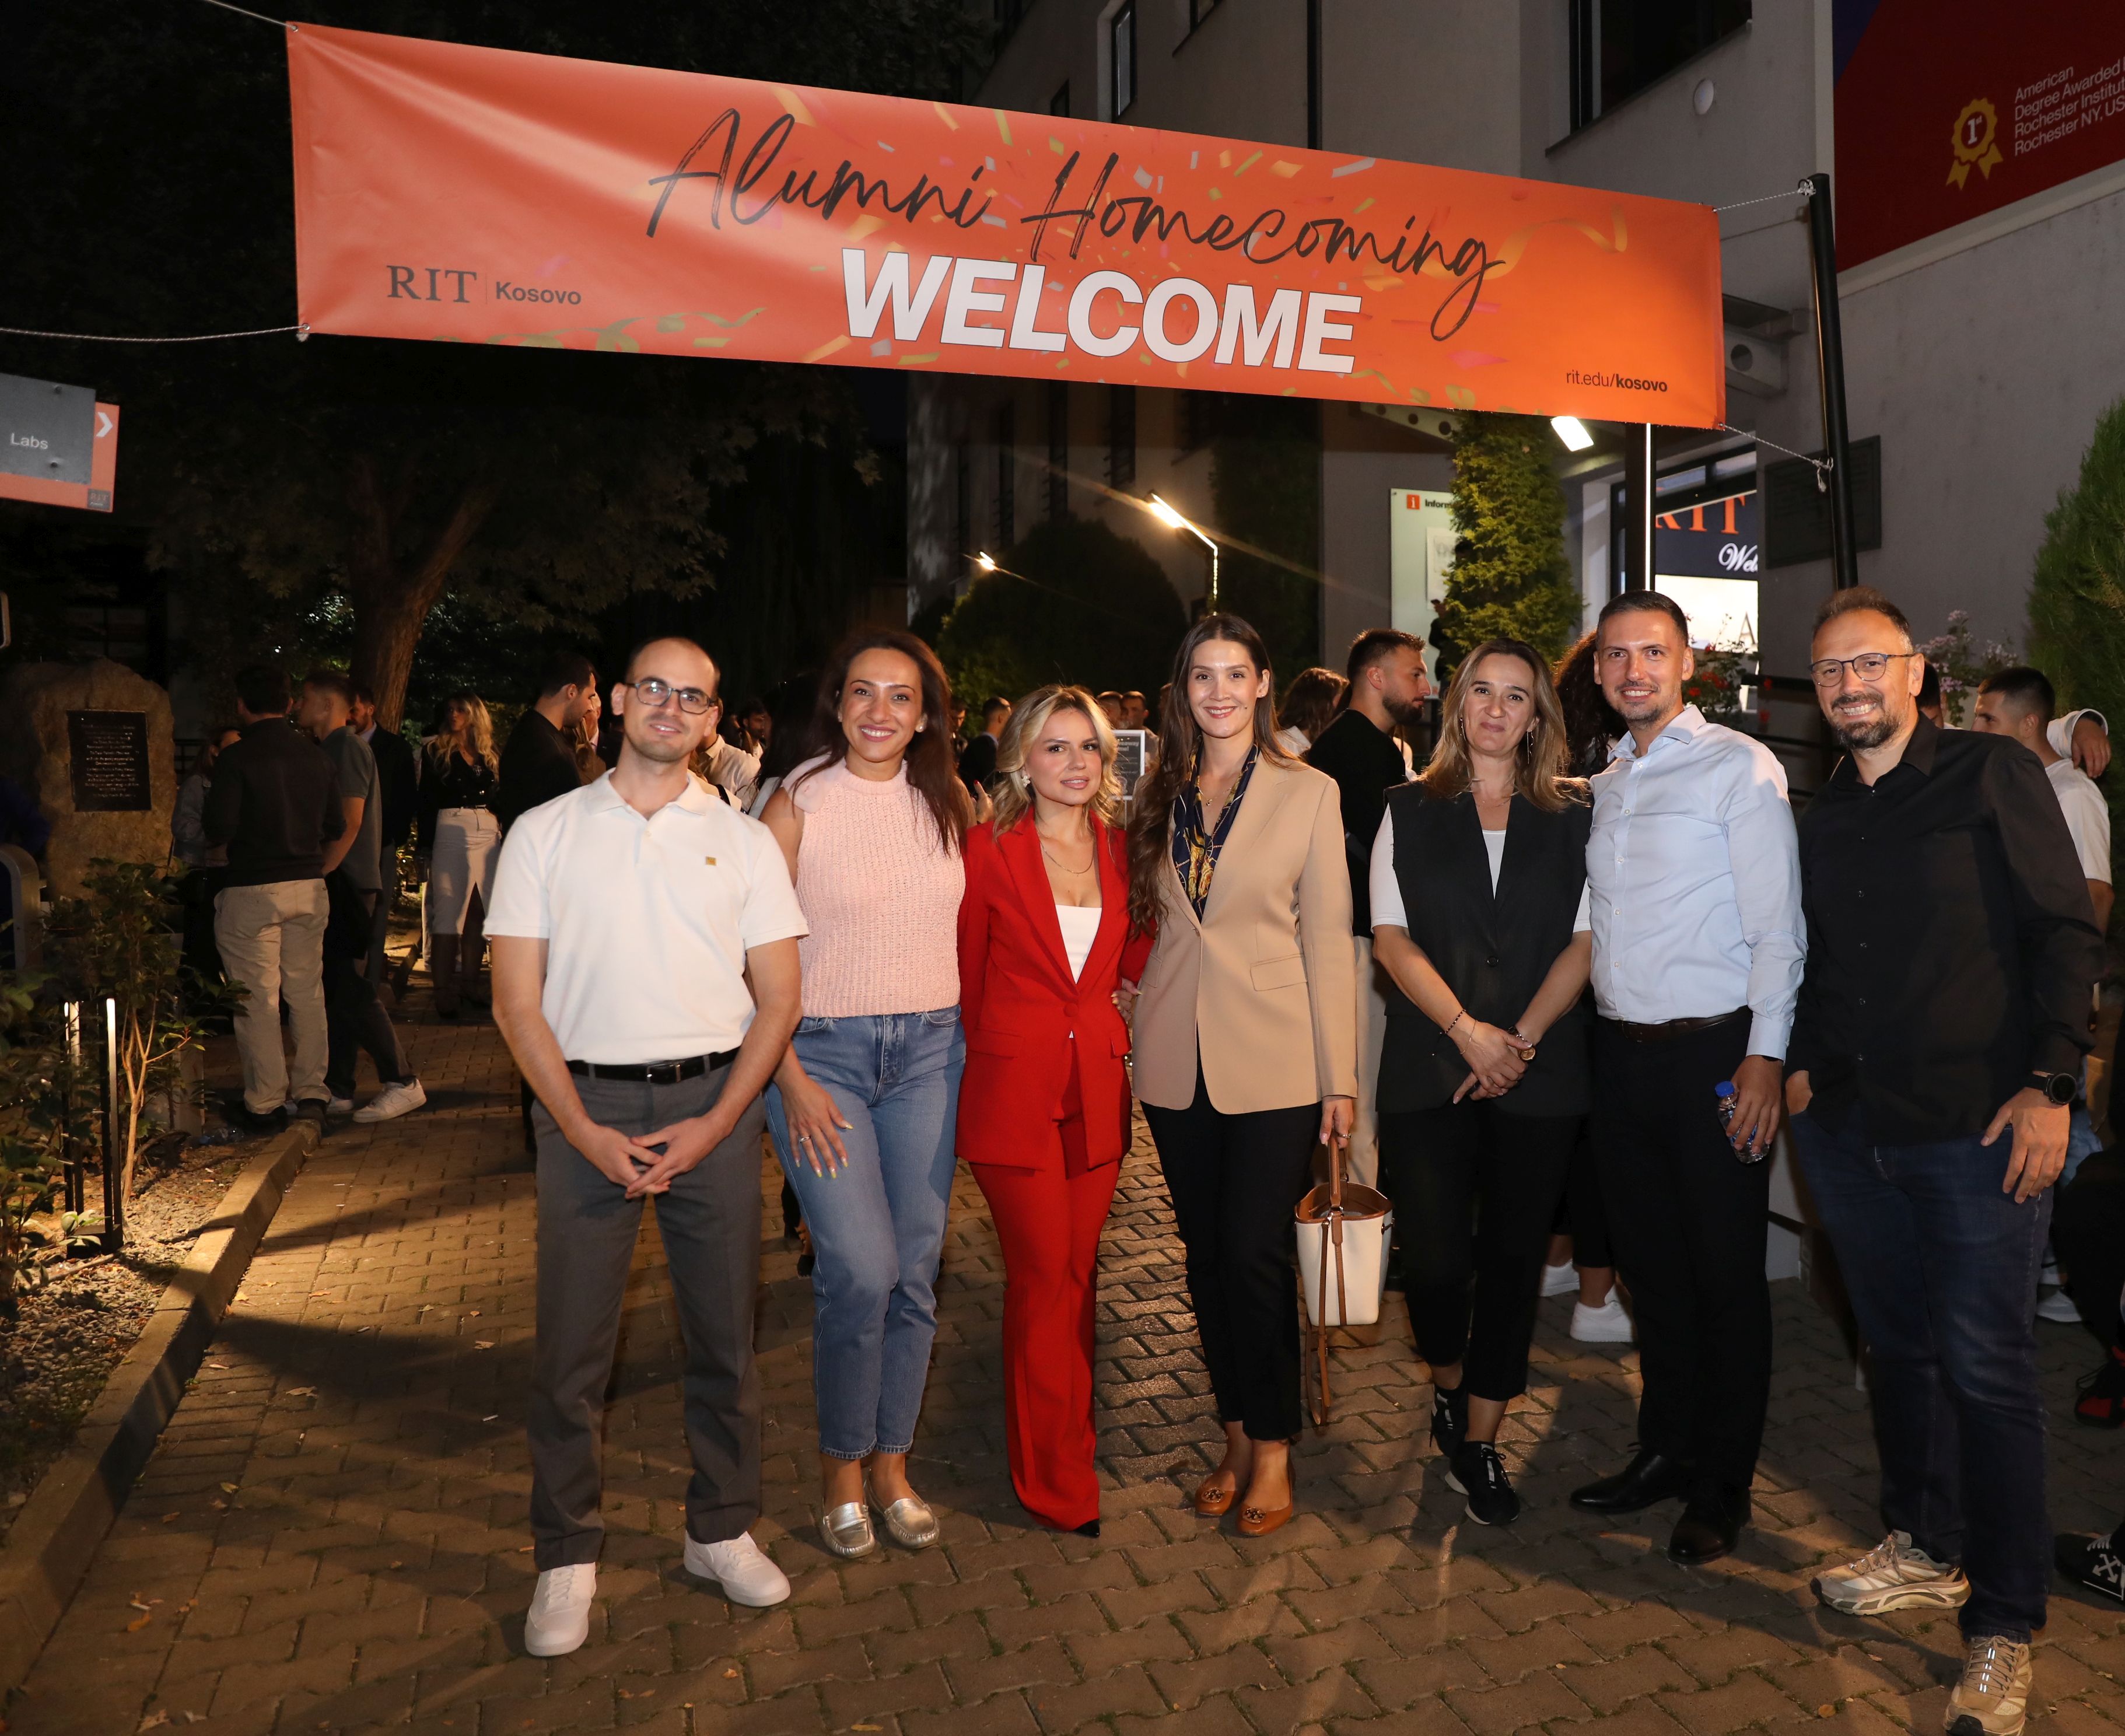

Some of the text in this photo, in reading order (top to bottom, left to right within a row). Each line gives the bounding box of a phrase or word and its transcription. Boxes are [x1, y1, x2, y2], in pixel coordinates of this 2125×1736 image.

[2014, 65, 2074, 103] American
[2015, 91, 2060, 121] Degree
[2061, 58, 2121, 100] Awarded
[2014, 100, 2080, 139] Rochester
[2014, 94, 2125, 157] Rochester NY, US
[646, 108, 1506, 341] Alumni Homecoming
[387, 265, 477, 303] RIT
[496, 281, 582, 305] Kosovo
[841, 247, 1362, 374] WELCOME
[1566, 369, 1668, 392] rit.edu/kosovo
[10, 433, 48, 450] Labs
[1425, 499, 1451, 508] Inform
[1718, 542, 1758, 572] Wel
